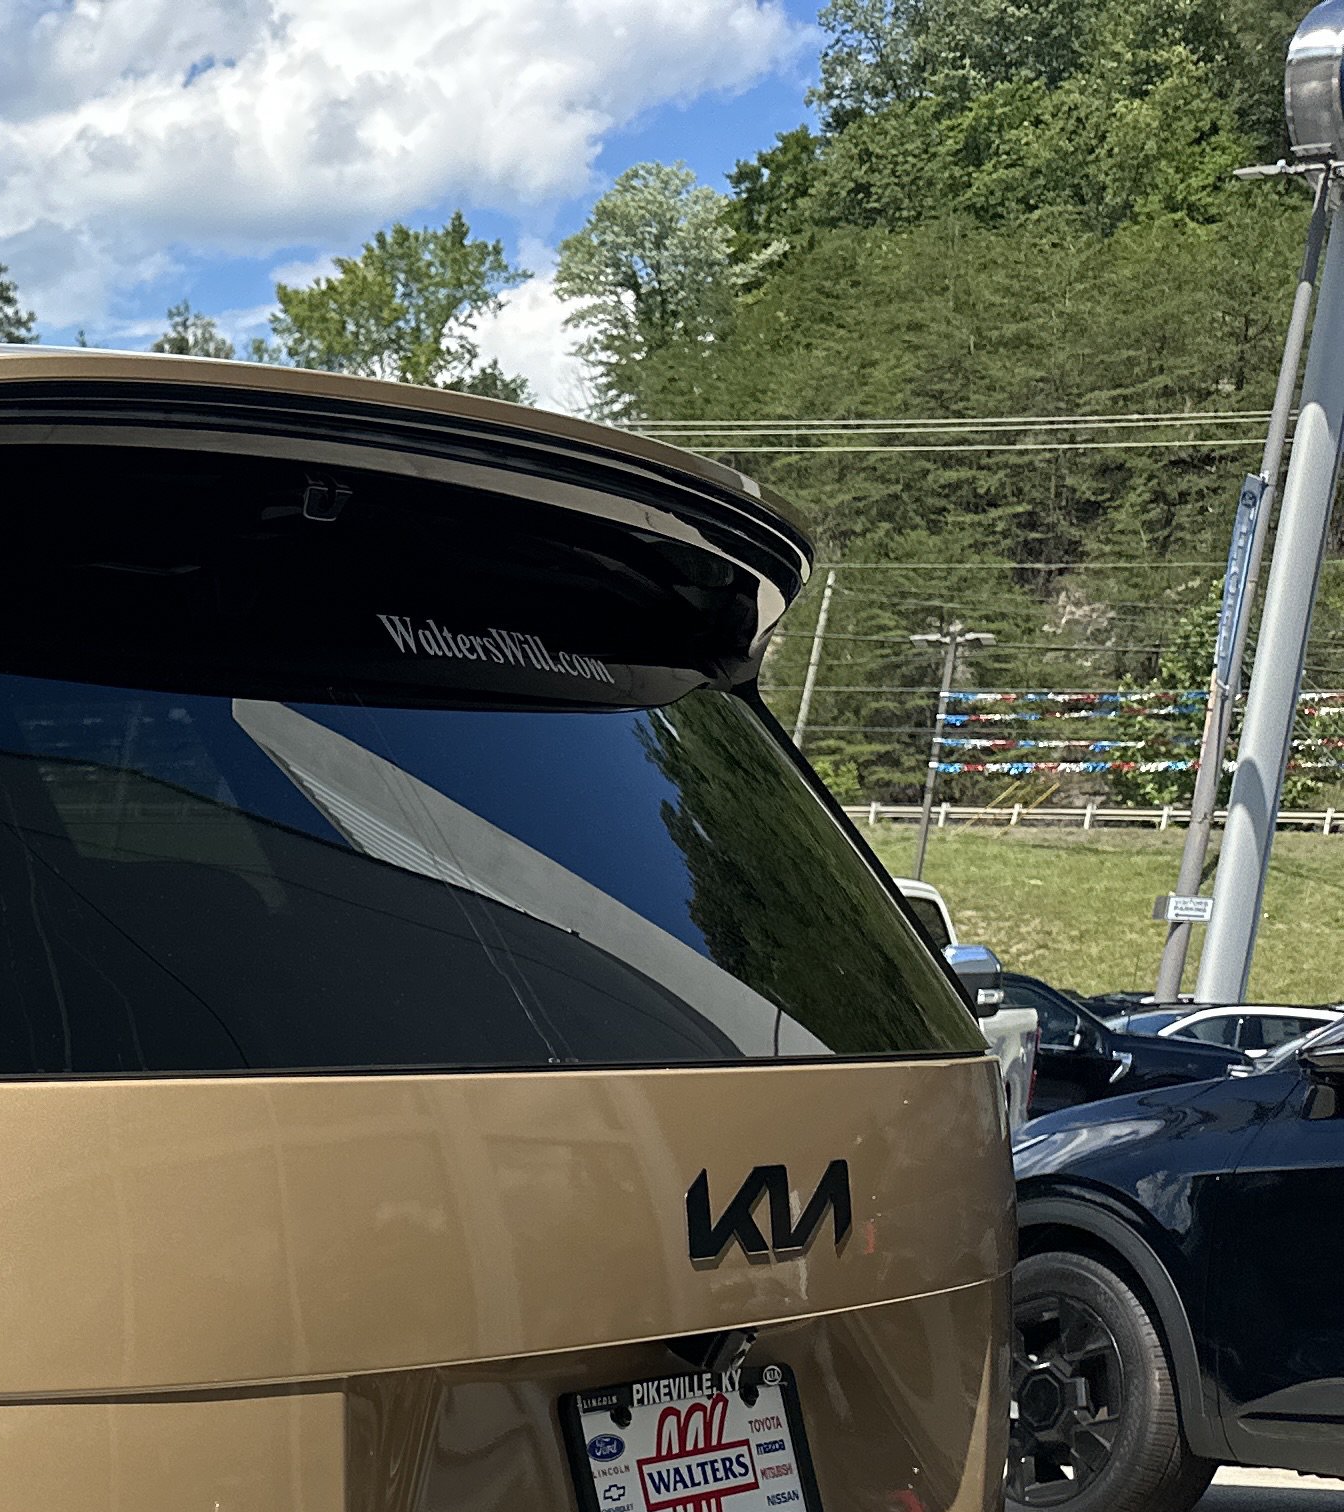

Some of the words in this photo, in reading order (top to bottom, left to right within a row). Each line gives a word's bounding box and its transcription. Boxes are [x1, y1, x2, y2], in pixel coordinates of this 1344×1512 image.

[376, 613, 614, 683] WaltersWill.com
[684, 1158, 853, 1260] KIA
[582, 1395, 618, 1409] LINCOLN
[632, 1372, 718, 1407] PIKEVILLE,
[721, 1368, 742, 1394] KY
[747, 1415, 783, 1434] TOYOTA
[592, 1464, 631, 1479] LINCOLN
[646, 1453, 750, 1495] WALTERS
[766, 1489, 800, 1506] NISSAN
